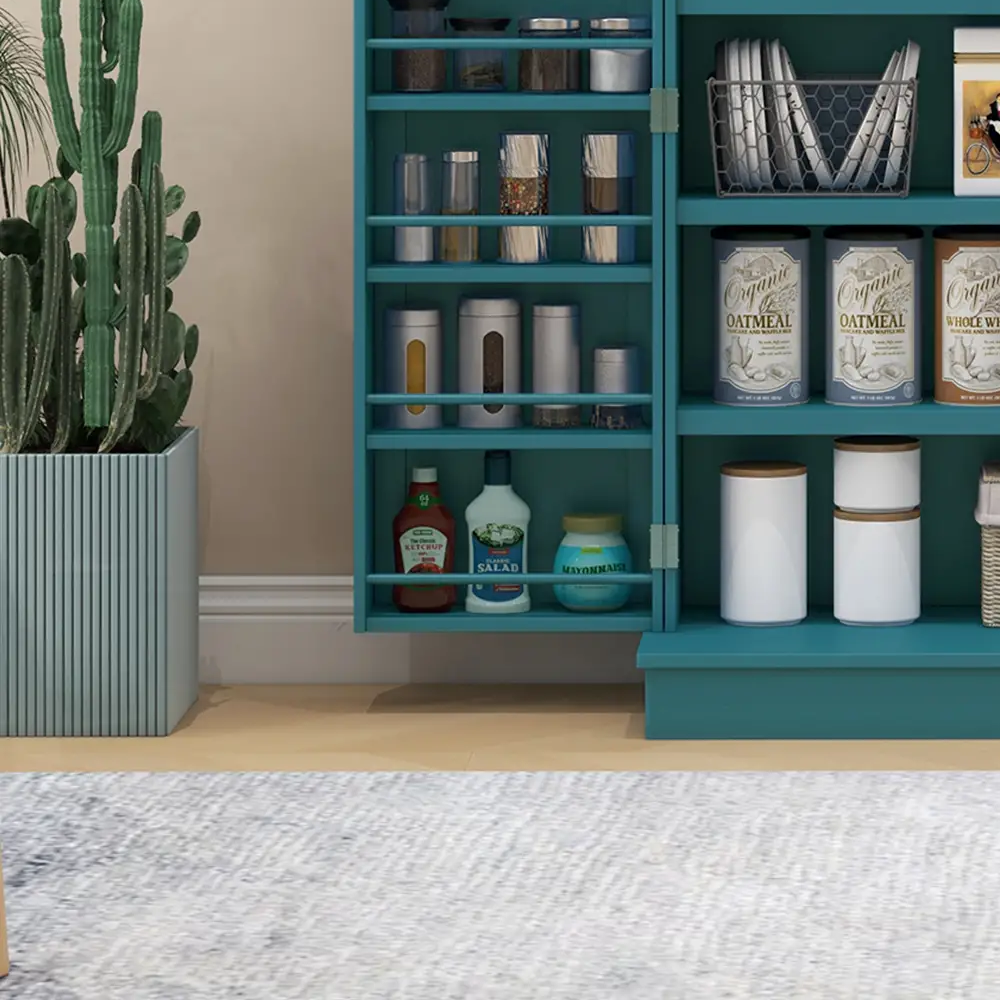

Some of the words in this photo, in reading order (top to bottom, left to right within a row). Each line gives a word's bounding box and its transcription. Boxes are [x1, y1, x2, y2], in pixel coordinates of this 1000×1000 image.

[724, 264, 791, 313] Organic
[837, 264, 904, 313] Organic
[726, 313, 792, 328] OATMEAL
[839, 313, 906, 328] OATMEAL
[946, 315, 982, 328] WHOLE
[477, 563, 519, 573] SALAD
